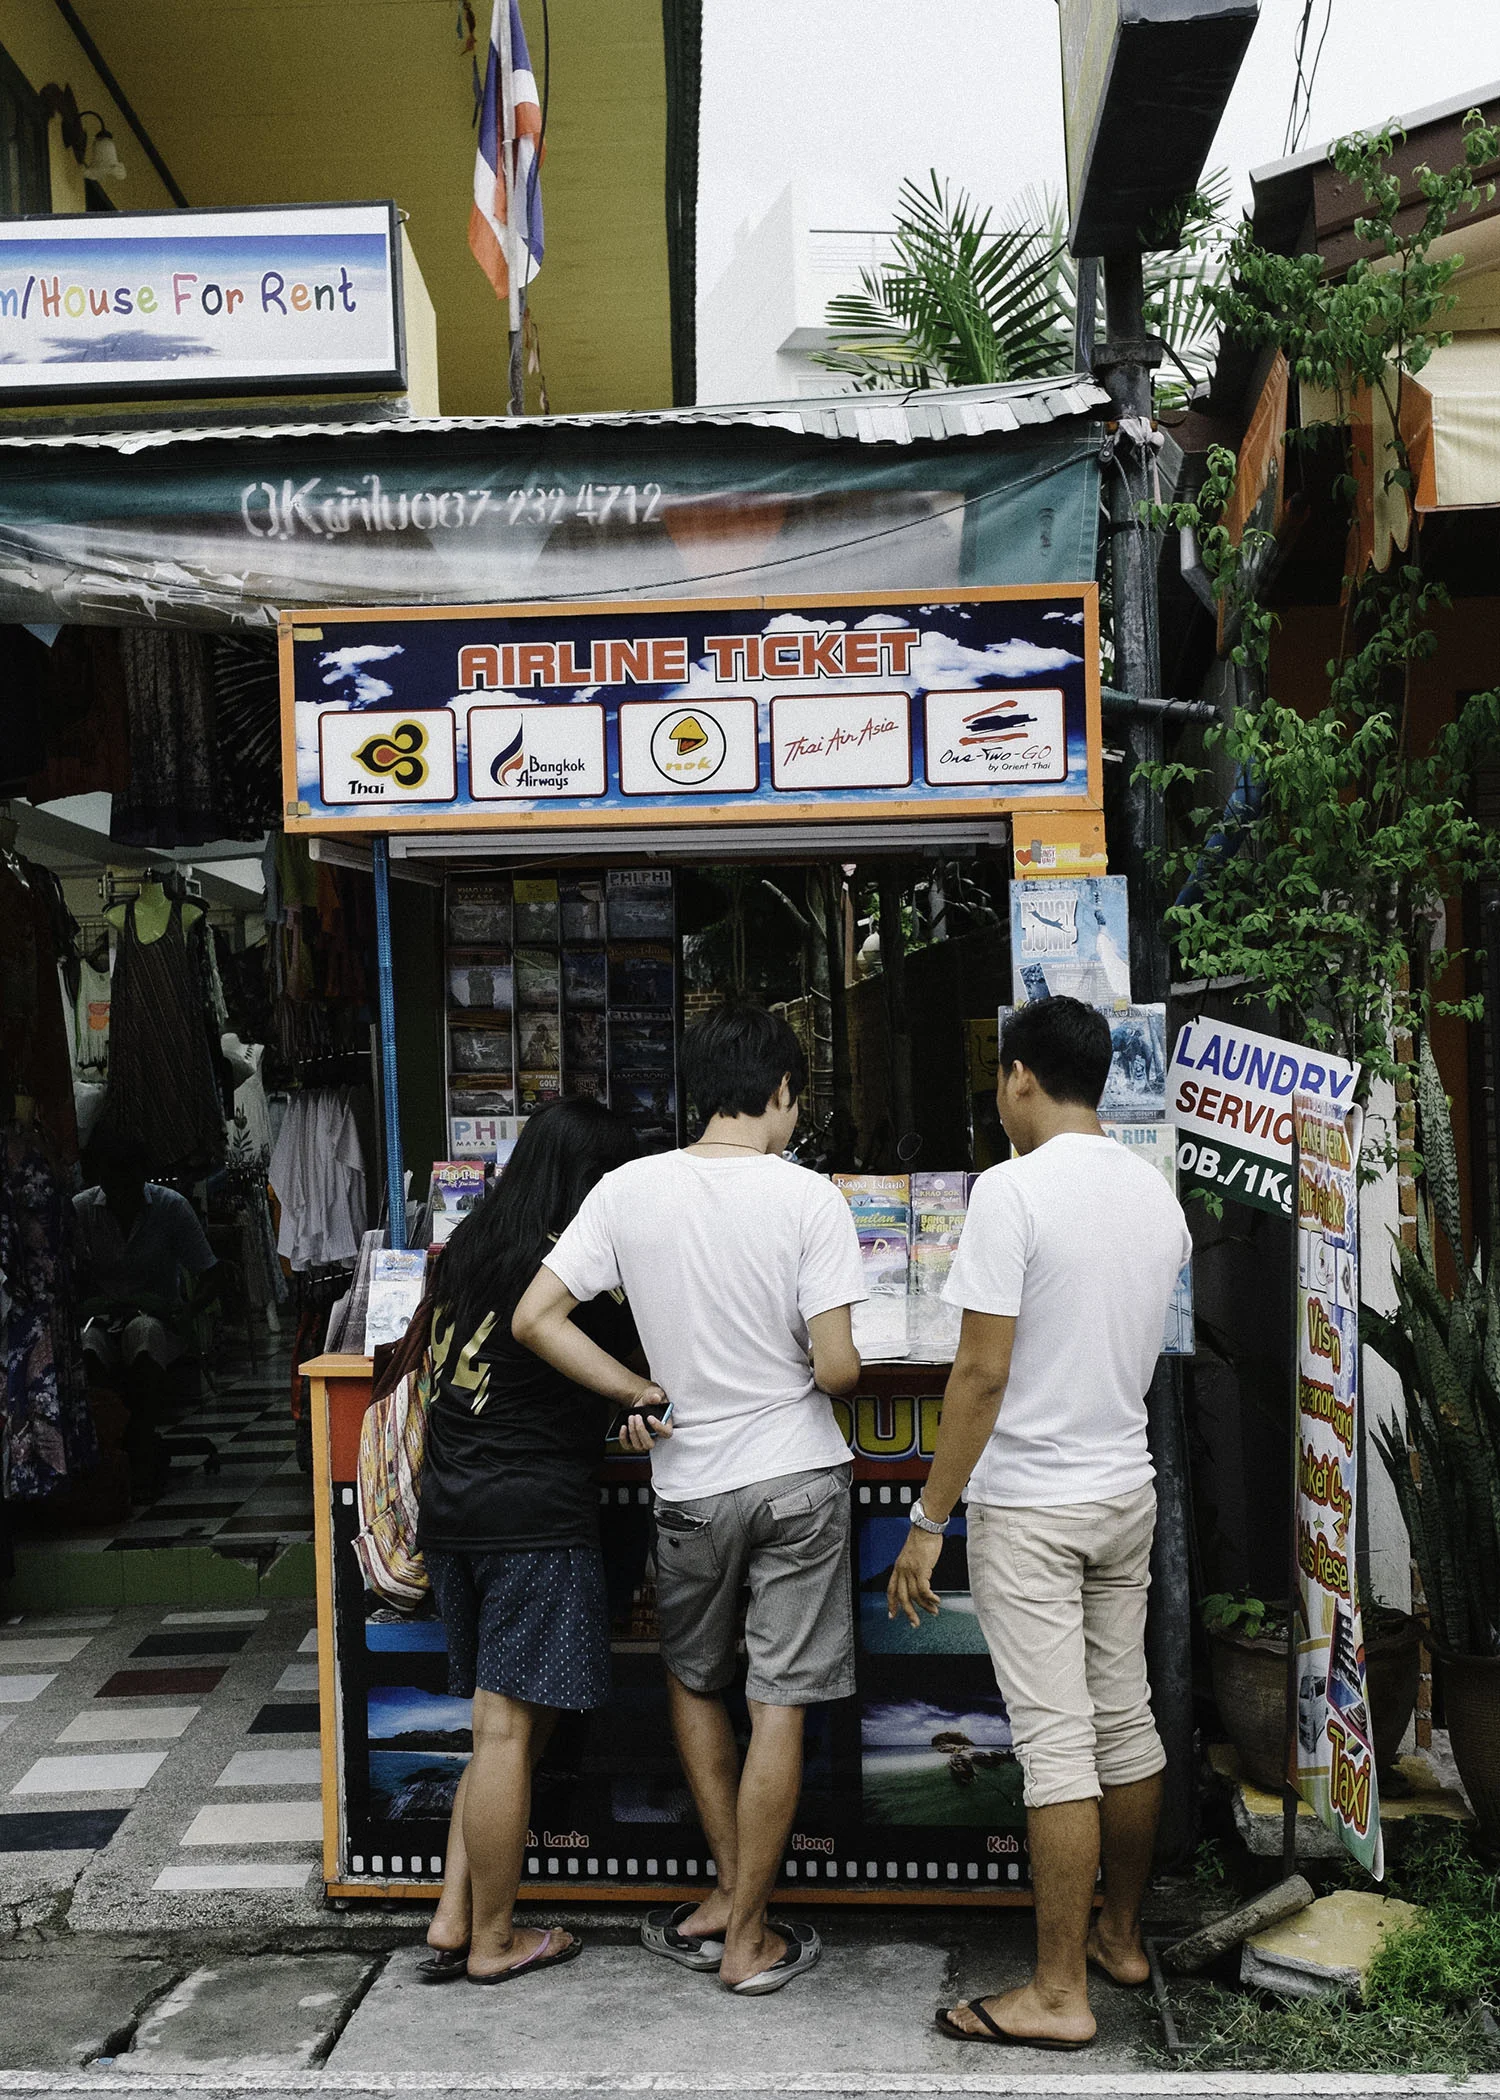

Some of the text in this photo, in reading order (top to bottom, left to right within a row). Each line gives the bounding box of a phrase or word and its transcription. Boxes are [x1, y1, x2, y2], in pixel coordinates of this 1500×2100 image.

[172, 271, 244, 316] For
[260, 267, 356, 316] Rent
[457, 628, 921, 691] AIRLINE TICKET
[784, 717, 899, 766] Thai Air Asia
[529, 755, 586, 774] Bangkok
[665, 758, 712, 772] nok
[988, 760, 1051, 773] by Orient Thai
[347, 780, 385, 795] Thai
[516, 772, 570, 790] Airways
[1022, 924, 1076, 951] JUMP
[1176, 1026, 1353, 1099] LAUNDRY
[1122, 1129, 1157, 1144] RUN
[872, 1176, 905, 1190] Island
[920, 1223, 952, 1233] SAFARI
[1329, 1725, 1370, 1827] Taxi
[543, 1830, 590, 1848] Lanta
[792, 1833, 834, 1854] Hong
[987, 1834, 1019, 1852] Koh
